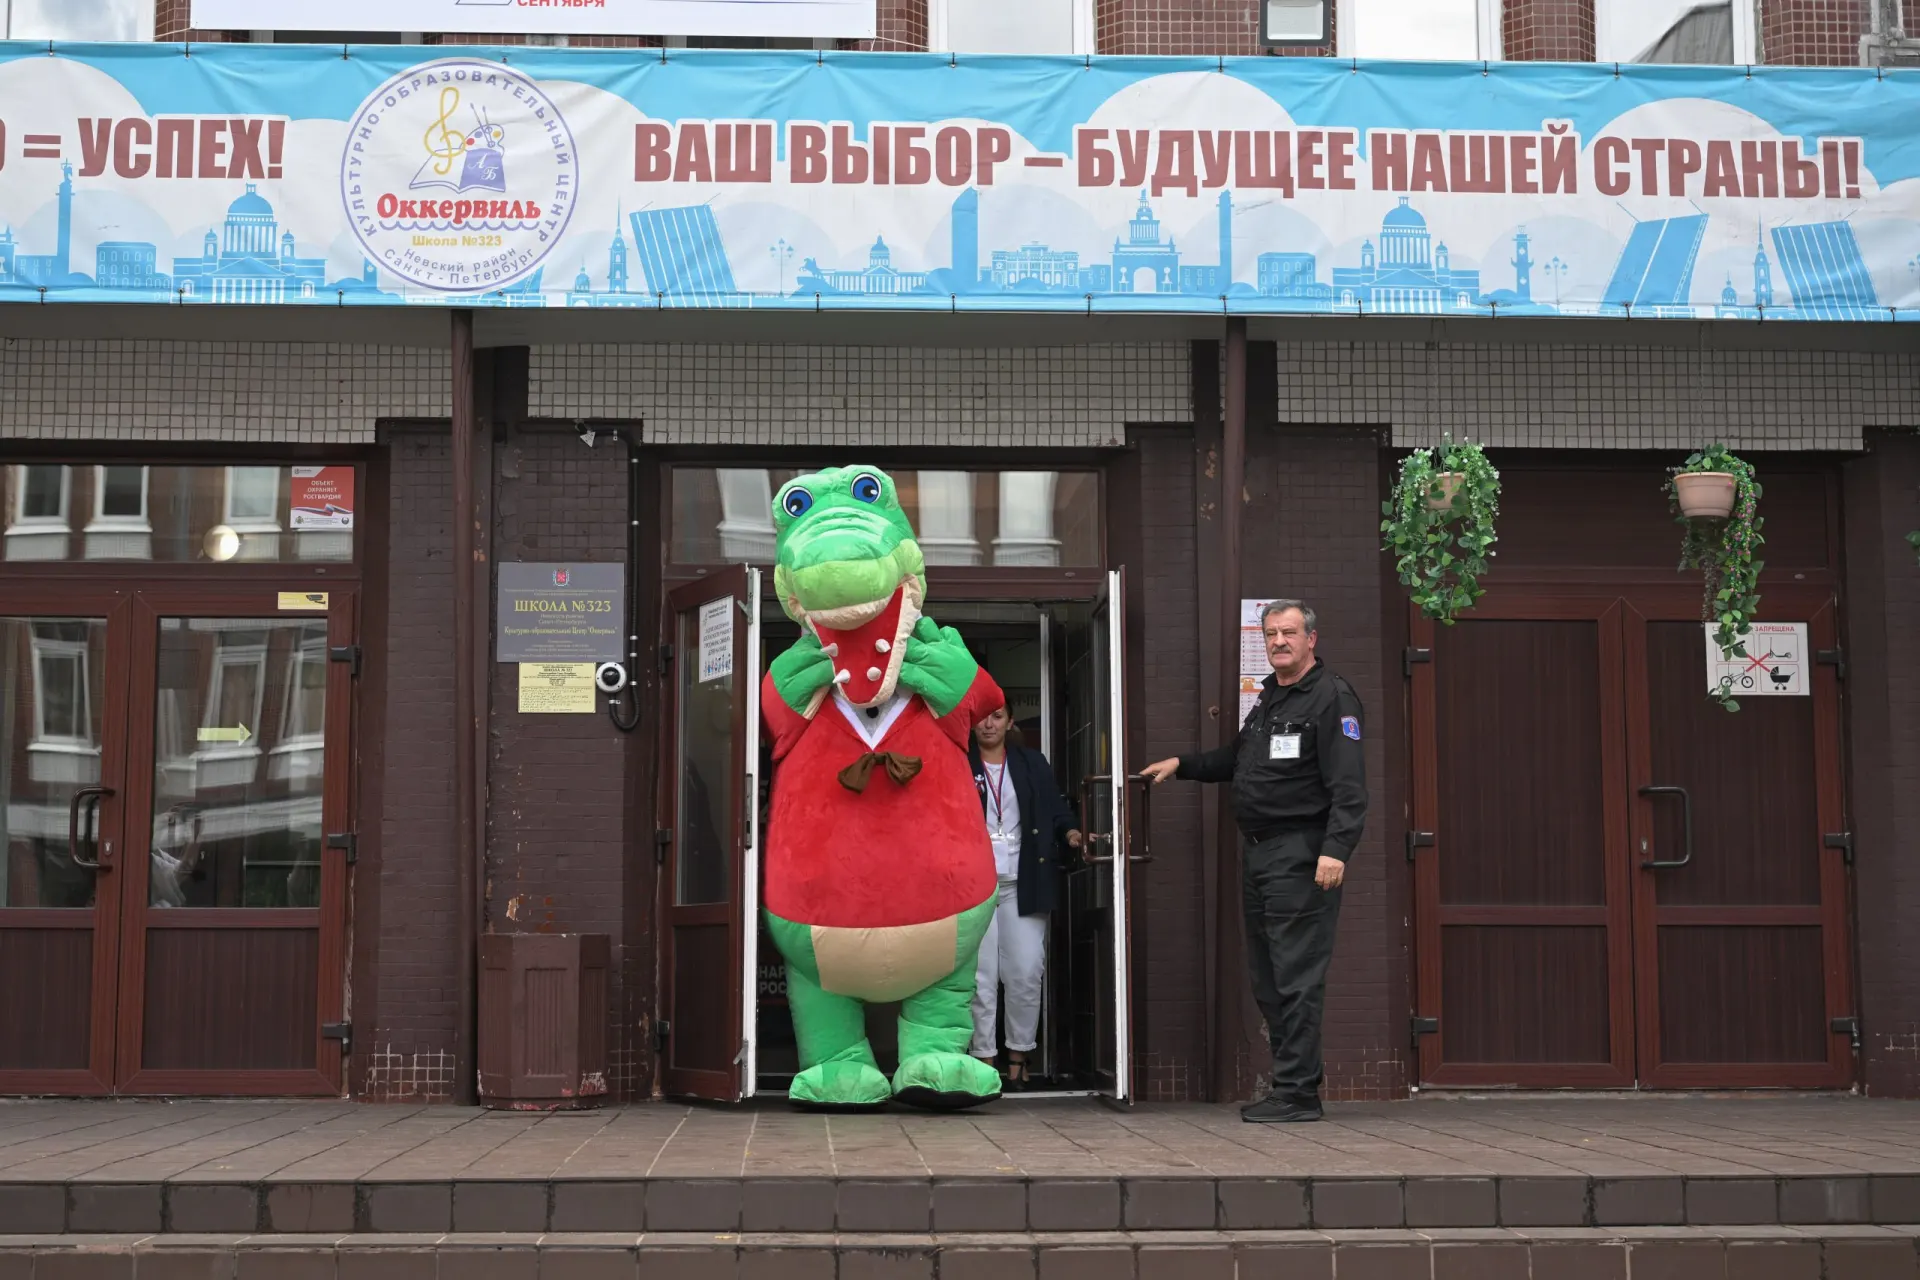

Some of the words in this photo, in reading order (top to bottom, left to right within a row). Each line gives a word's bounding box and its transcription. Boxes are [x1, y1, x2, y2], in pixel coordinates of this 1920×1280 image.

[77, 117, 286, 179] УСПЕХ!
[349, 70, 570, 236] КУЛЬТУРНО-ОБРАЗОВАТЕЛЬНЫЙ
[538, 174, 569, 242] ЦЕНТР
[634, 123, 772, 183] ВАШ
[790, 125, 1011, 187] ВЫБОР
[1078, 128, 1356, 199] БУДУЩЕЕ
[1371, 123, 1577, 194] НАШЕЙ
[1593, 136, 1860, 199] СТРАНЫ!
[376, 193, 541, 225] Оккервиль
[412, 235, 458, 246] Школа
[461, 235, 502, 247] №323
[404, 248, 464, 272] Невский
[473, 247, 516, 270] район
[514, 600, 568, 612] ШКОЛА
[759, 965, 786, 979] НАР
[760, 981, 787, 994] РОС
